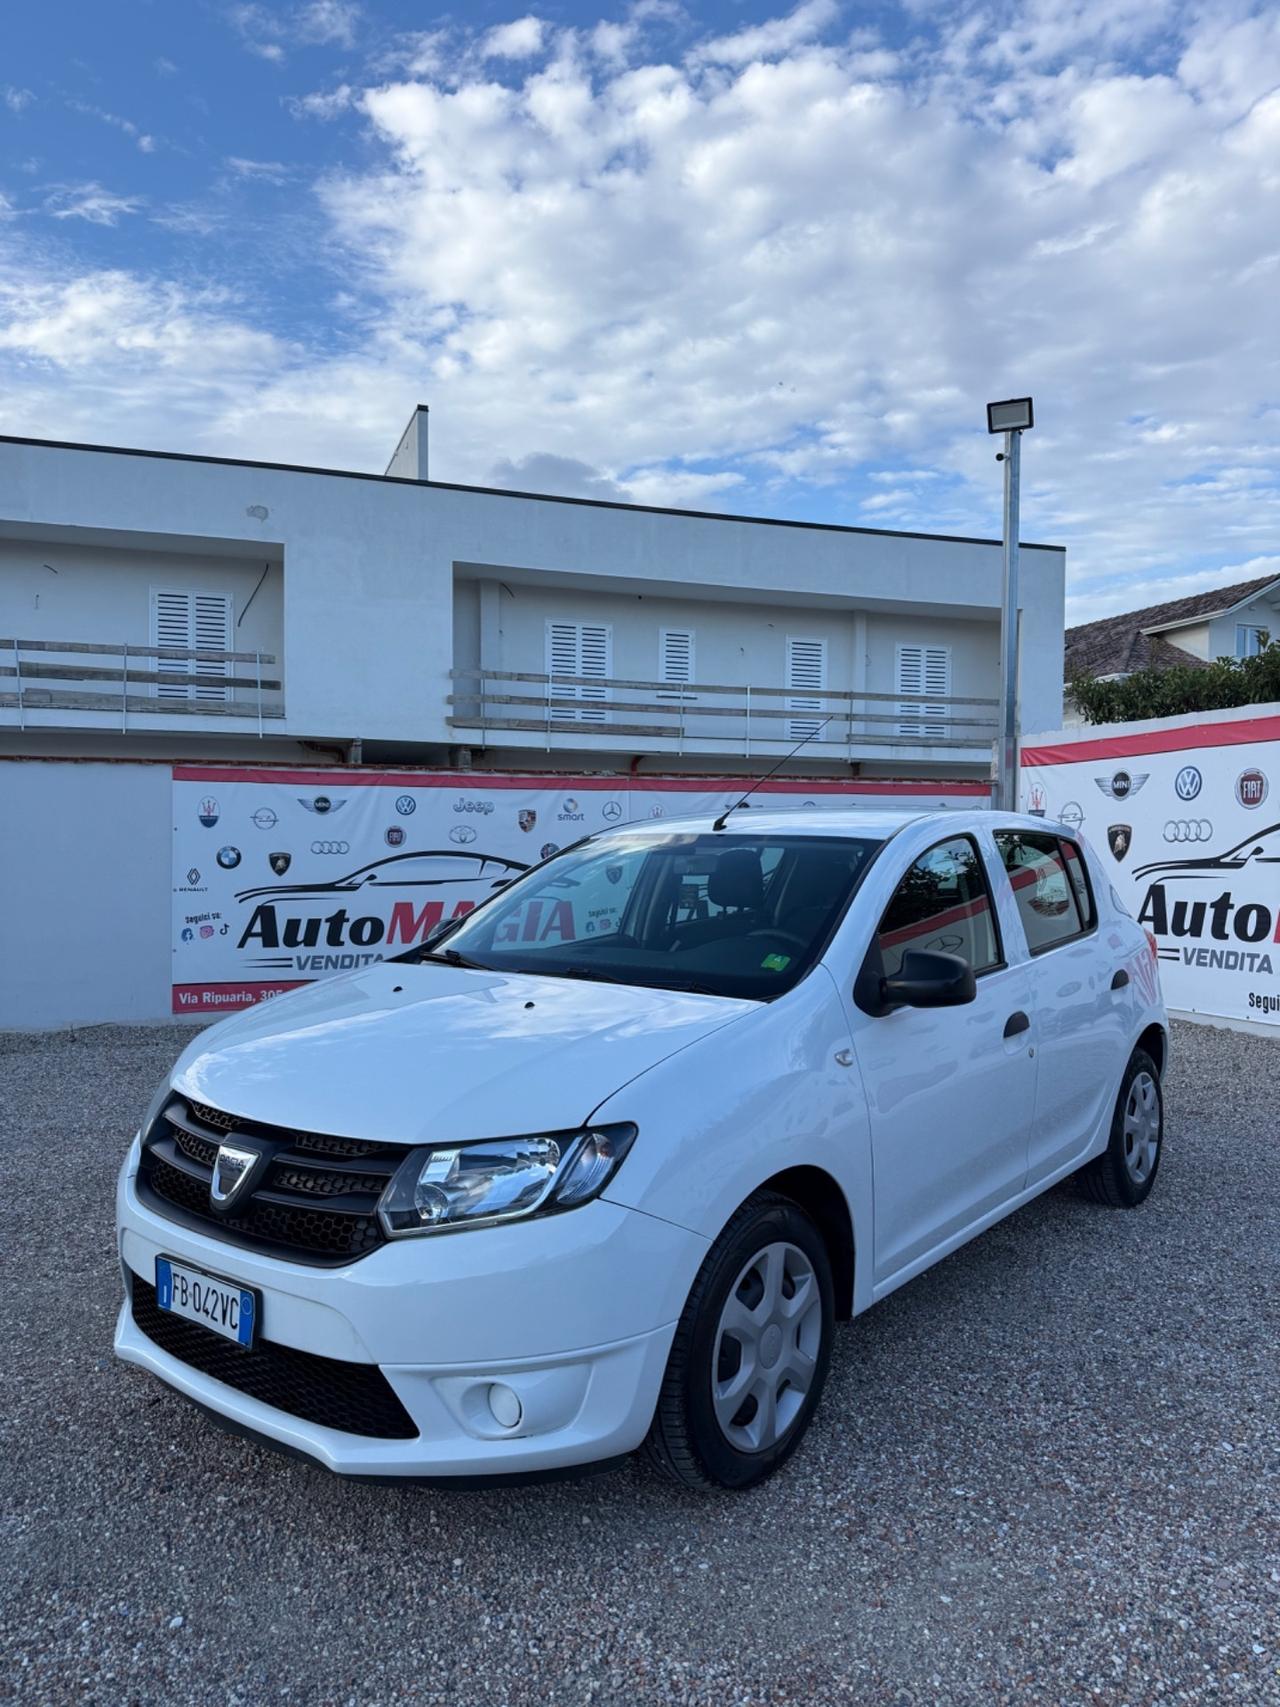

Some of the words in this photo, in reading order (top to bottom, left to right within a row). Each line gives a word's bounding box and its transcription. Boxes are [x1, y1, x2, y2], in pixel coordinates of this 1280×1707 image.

[1243, 780, 1262, 799] FIAT
[452, 797, 495, 815] Jeep
[557, 813, 585, 822] smart
[1137, 884, 1280, 944] Auto
[296, 953, 384, 971] VENDITA
[1183, 947, 1274, 975] VENDITA
[179, 992, 199, 1005] Via
[202, 990, 257, 1005] Ripuaria,
